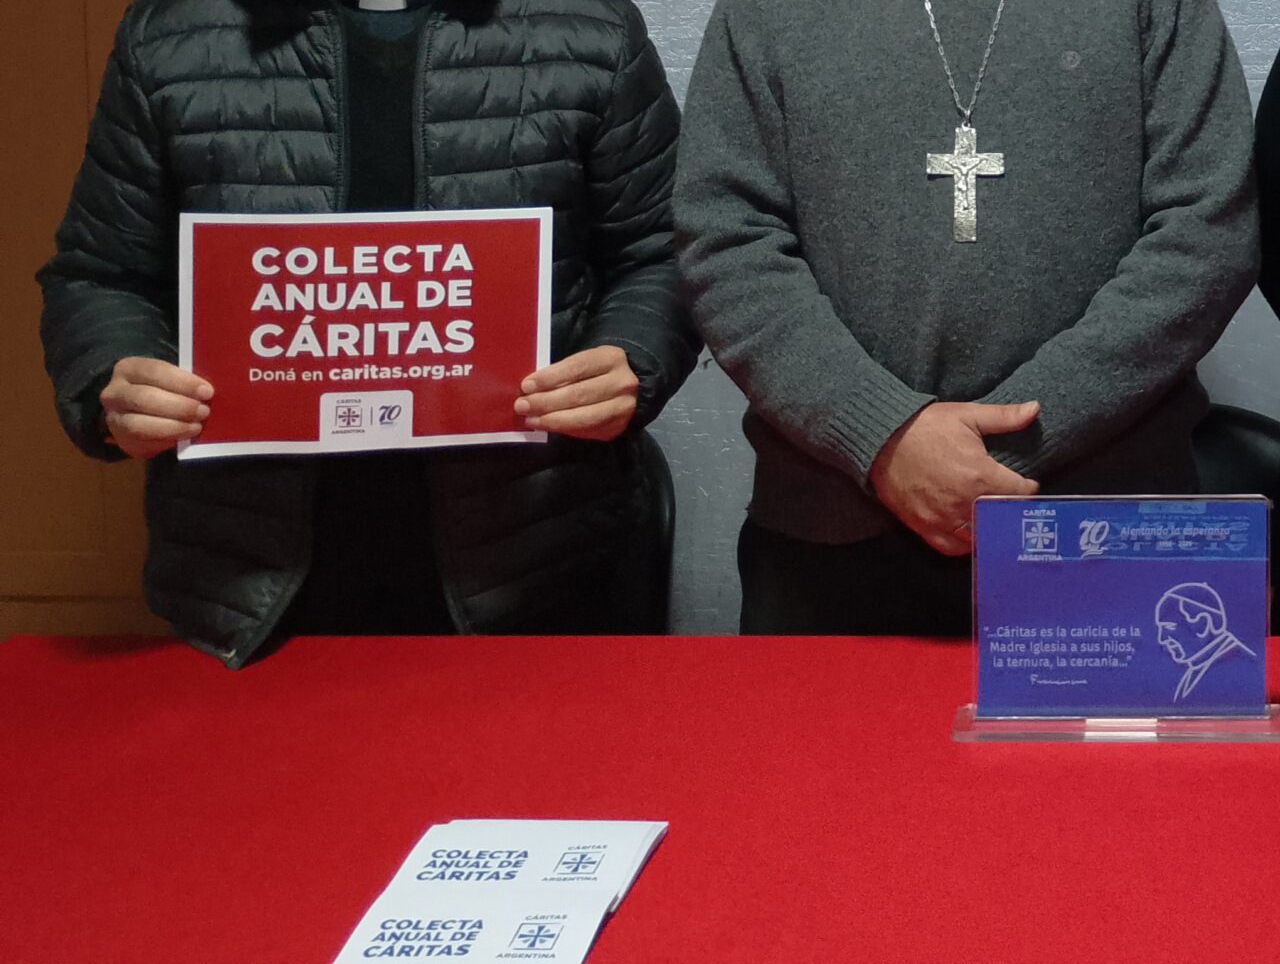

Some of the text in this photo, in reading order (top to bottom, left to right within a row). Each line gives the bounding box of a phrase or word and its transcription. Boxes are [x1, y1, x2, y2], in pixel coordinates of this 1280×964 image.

[252, 243, 474, 276] COLECTA
[251, 279, 473, 312] ANUAL DE
[249, 315, 475, 358] CÁRITAS
[249, 363, 473, 382] Doná en caritas.org.ar
[1040, 628, 1053, 637] es
[1056, 626, 1067, 637] la
[1070, 626, 1108, 637] caricia
[1112, 626, 1127, 637] de
[1130, 626, 1141, 637] la
[990, 641, 1026, 652] Madre
[1029, 641, 1067, 654] Iglesia
[1070, 643, 1077, 652] a
[1080, 643, 1100, 652] sus
[993, 656, 1004, 667] la
[1056, 656, 1067, 667] la
[431, 849, 529, 860] COLECTA
[423, 859, 526, 869] ANUAL DE
[416, 867, 518, 882] CÁRITAS
[379, 919, 484, 931] COLECTA
[371, 931, 481, 942] ANUAL DE
[362, 940, 472, 958] CÁRITAS
